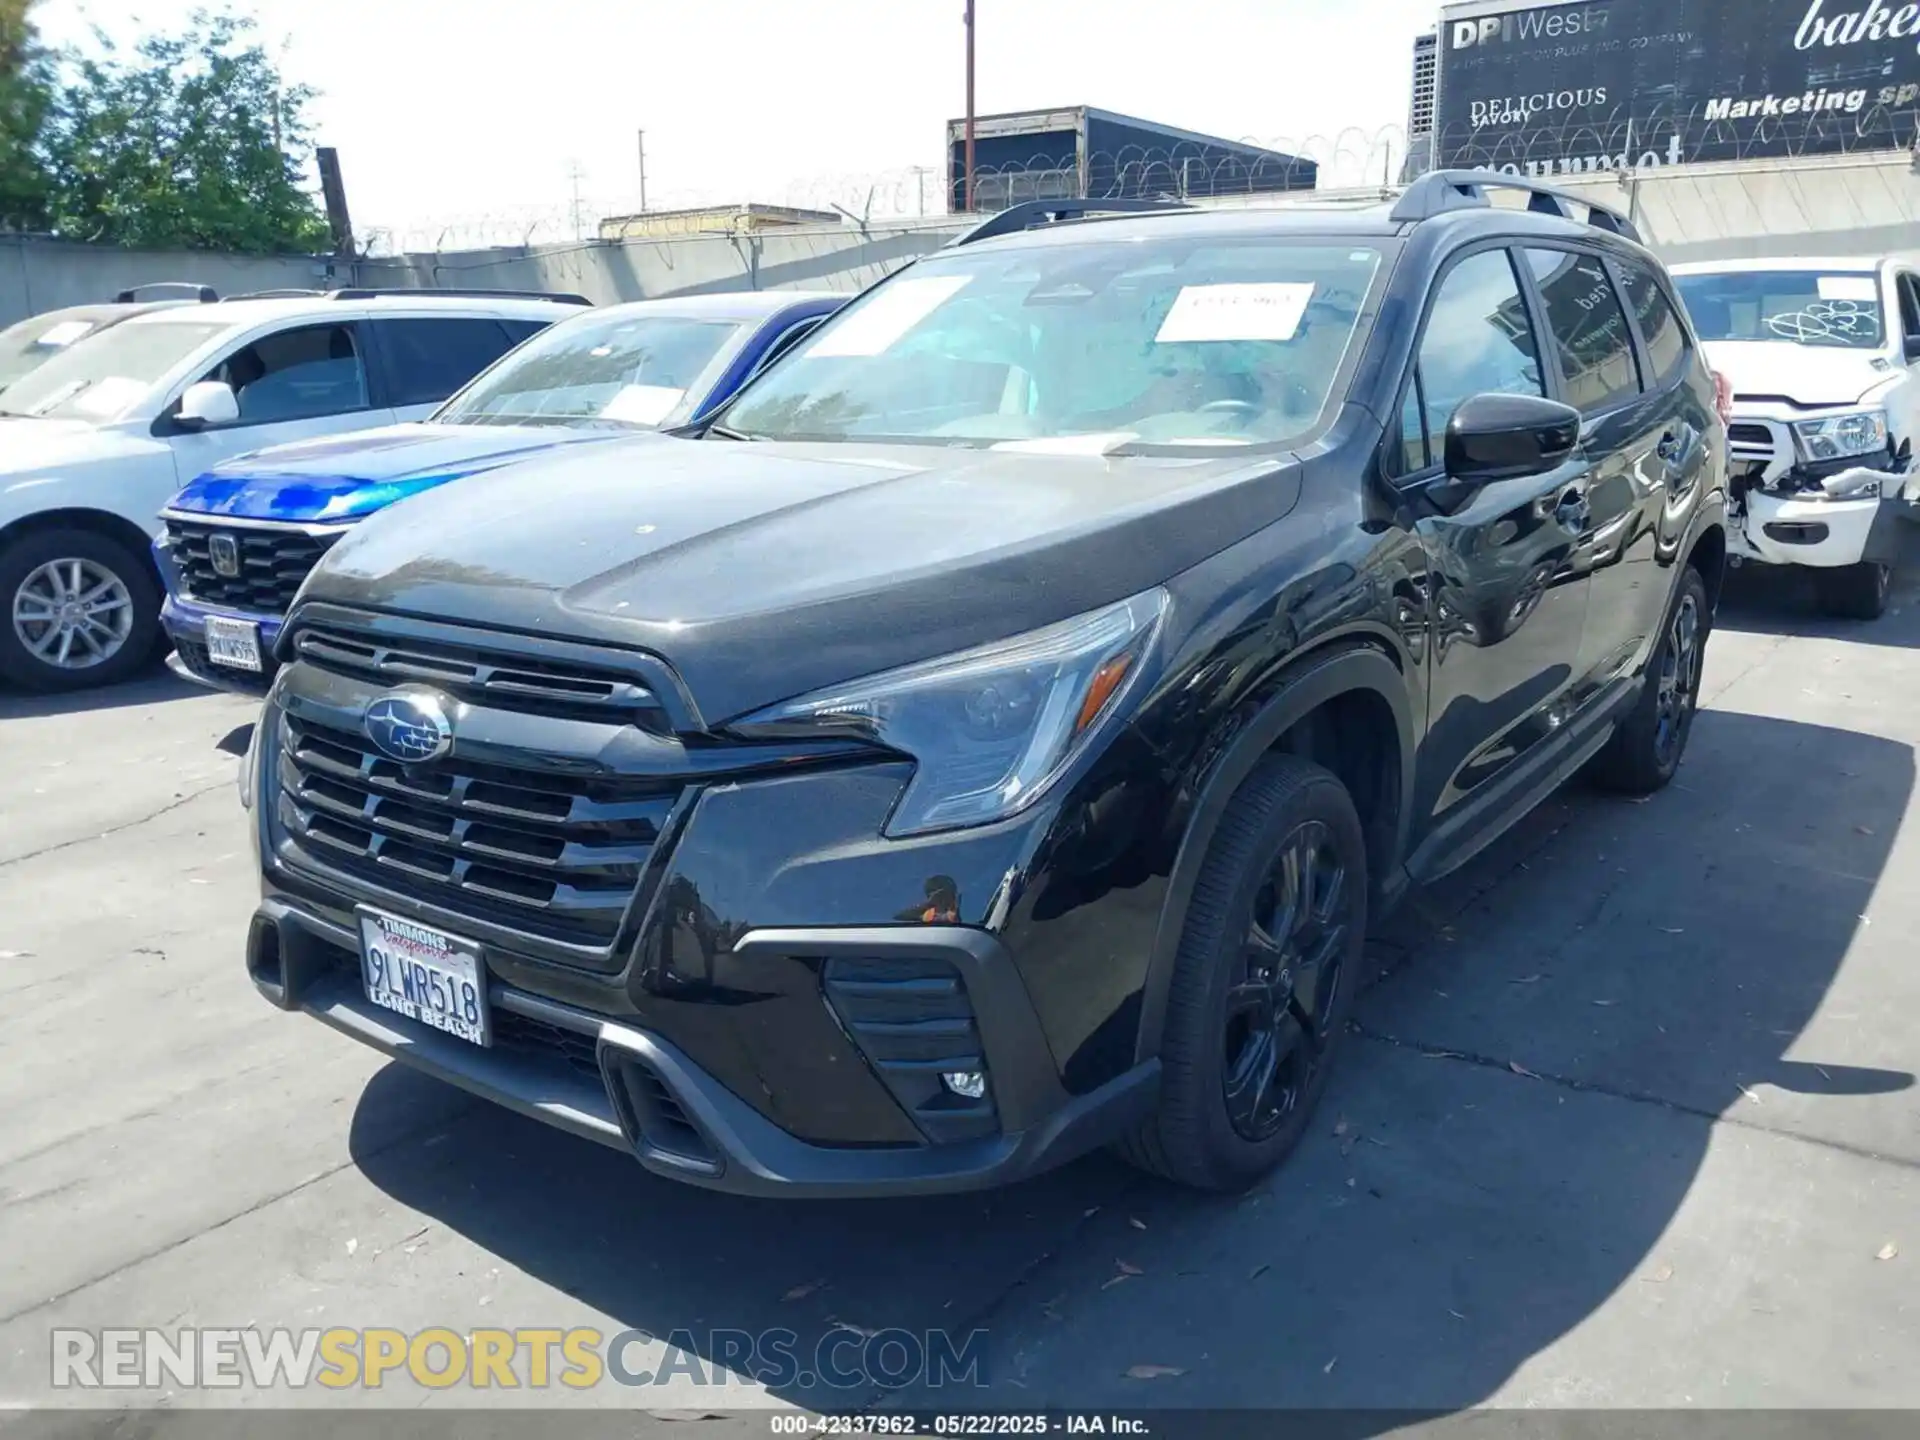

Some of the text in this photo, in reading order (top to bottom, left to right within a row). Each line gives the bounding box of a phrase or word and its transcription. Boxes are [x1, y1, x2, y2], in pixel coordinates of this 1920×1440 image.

[1793, 0, 1920, 50] bake
[1471, 87, 1607, 119] DELICIOUS
[1471, 110, 1531, 127] SAVORY
[1704, 88, 1867, 120] Marketing
[382, 919, 447, 950] TIMMONS
[369, 947, 478, 1026] 9LWR518
[421, 1007, 483, 1046] BEACH
